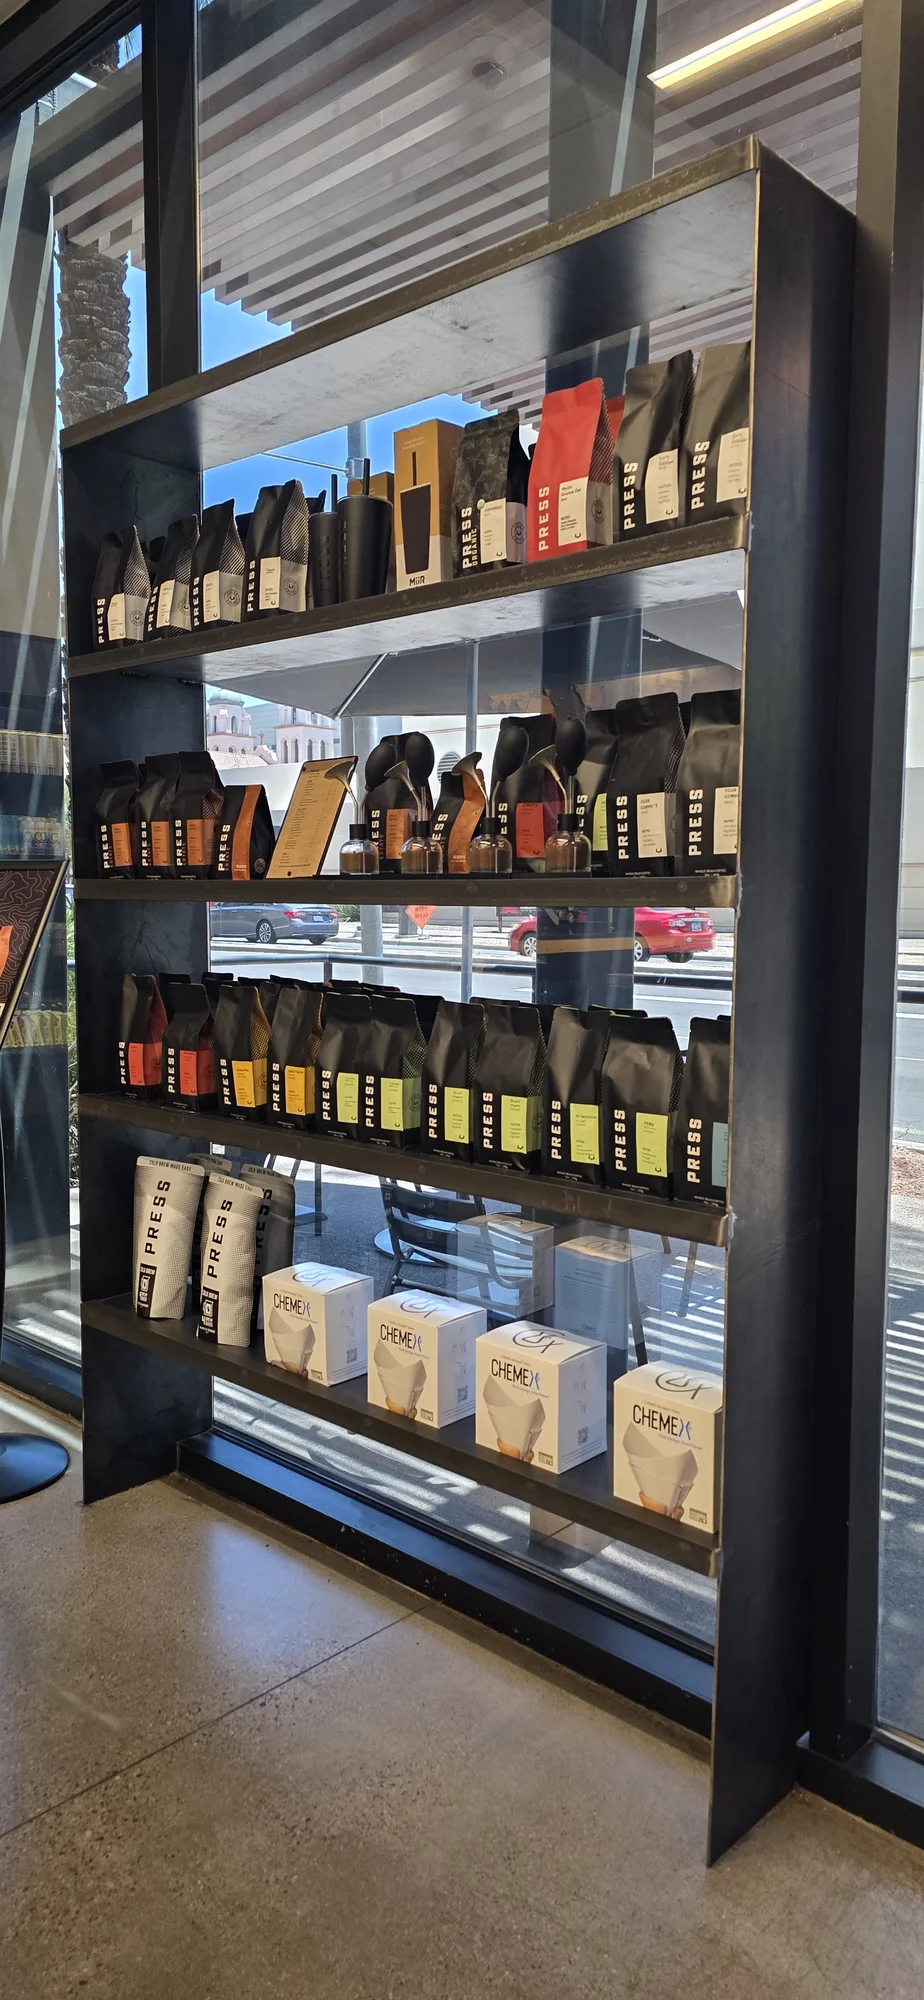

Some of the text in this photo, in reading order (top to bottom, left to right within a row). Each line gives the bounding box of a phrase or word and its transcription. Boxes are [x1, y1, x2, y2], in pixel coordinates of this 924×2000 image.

[624, 462, 638, 530] PRESS
[691, 440, 710, 510] PRESS
[462, 506, 473, 569] PRESS
[538, 486, 550, 552] PRESS
[247, 560, 256, 612] PRESS
[409, 575, 426, 587] MiiR
[97, 598, 106, 644] PRESS
[147, 586, 159, 632] PRESS
[101, 825, 110, 868] PRESS
[175, 820, 183, 866] PRESS
[616, 796, 630, 860] PRESS
[688, 789, 704, 856] PRESS
[218, 824, 230, 872] PRESS
[118, 1042, 126, 1084] PRESS
[168, 1048, 176, 1093] PRESS
[220, 1058, 232, 1105] PRESS
[272, 1063, 280, 1112] PRESS
[322, 1070, 332, 1120] PRESS
[366, 1075, 374, 1128] PRESS
[428, 1084, 438, 1138] PRESS
[482, 1092, 494, 1149] PRESS
[551, 1100, 562, 1160] PRESS
[614, 1109, 627, 1172] PRESS
[686, 1118, 702, 1184] PRESS
[225, 1178, 234, 1186] BREW
[235, 1181, 244, 1190] MADE
[144, 1180, 171, 1255] PRESS
[207, 1199, 233, 1279] PRESS
[274, 1293, 311, 1318] CHEMEX
[380, 1324, 422, 1352] CHEMEX
[491, 1358, 540, 1391] CHEMEX
[632, 1404, 692, 1441] CHEMEX
